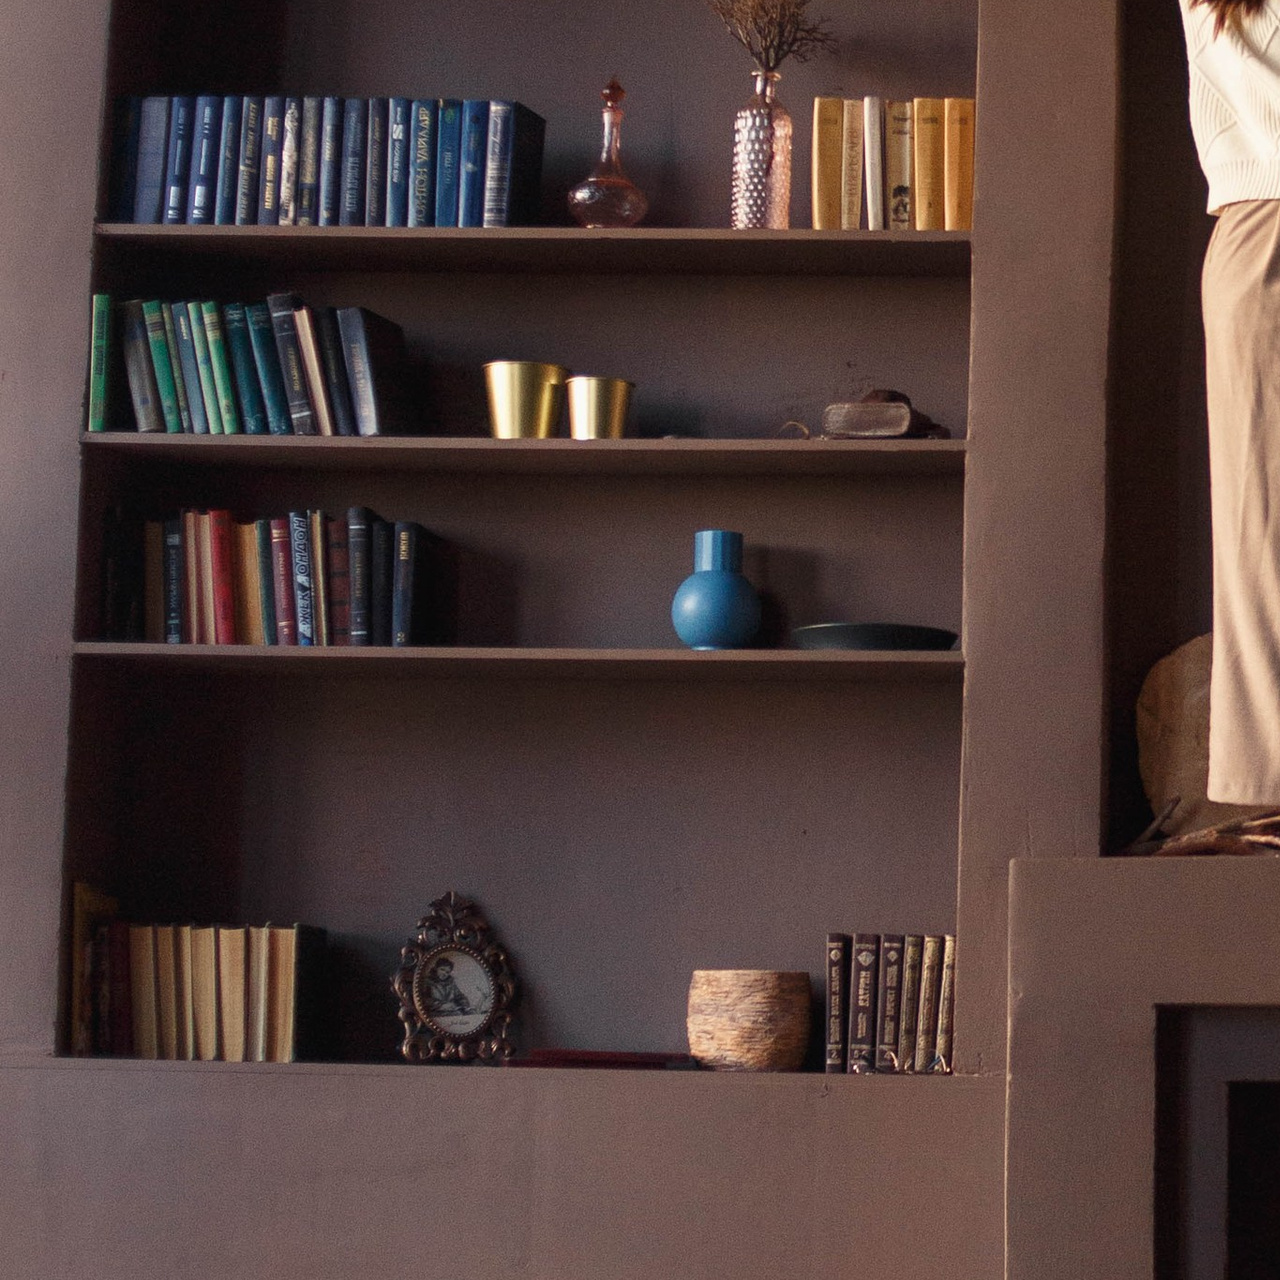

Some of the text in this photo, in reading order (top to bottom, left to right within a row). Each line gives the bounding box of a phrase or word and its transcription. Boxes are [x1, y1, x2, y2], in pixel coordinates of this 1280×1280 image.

[413, 106, 430, 221] ТОРНТОН УАЙЛДЕР
[293, 516, 311, 637] ДЖЕК ЛОНДОН
